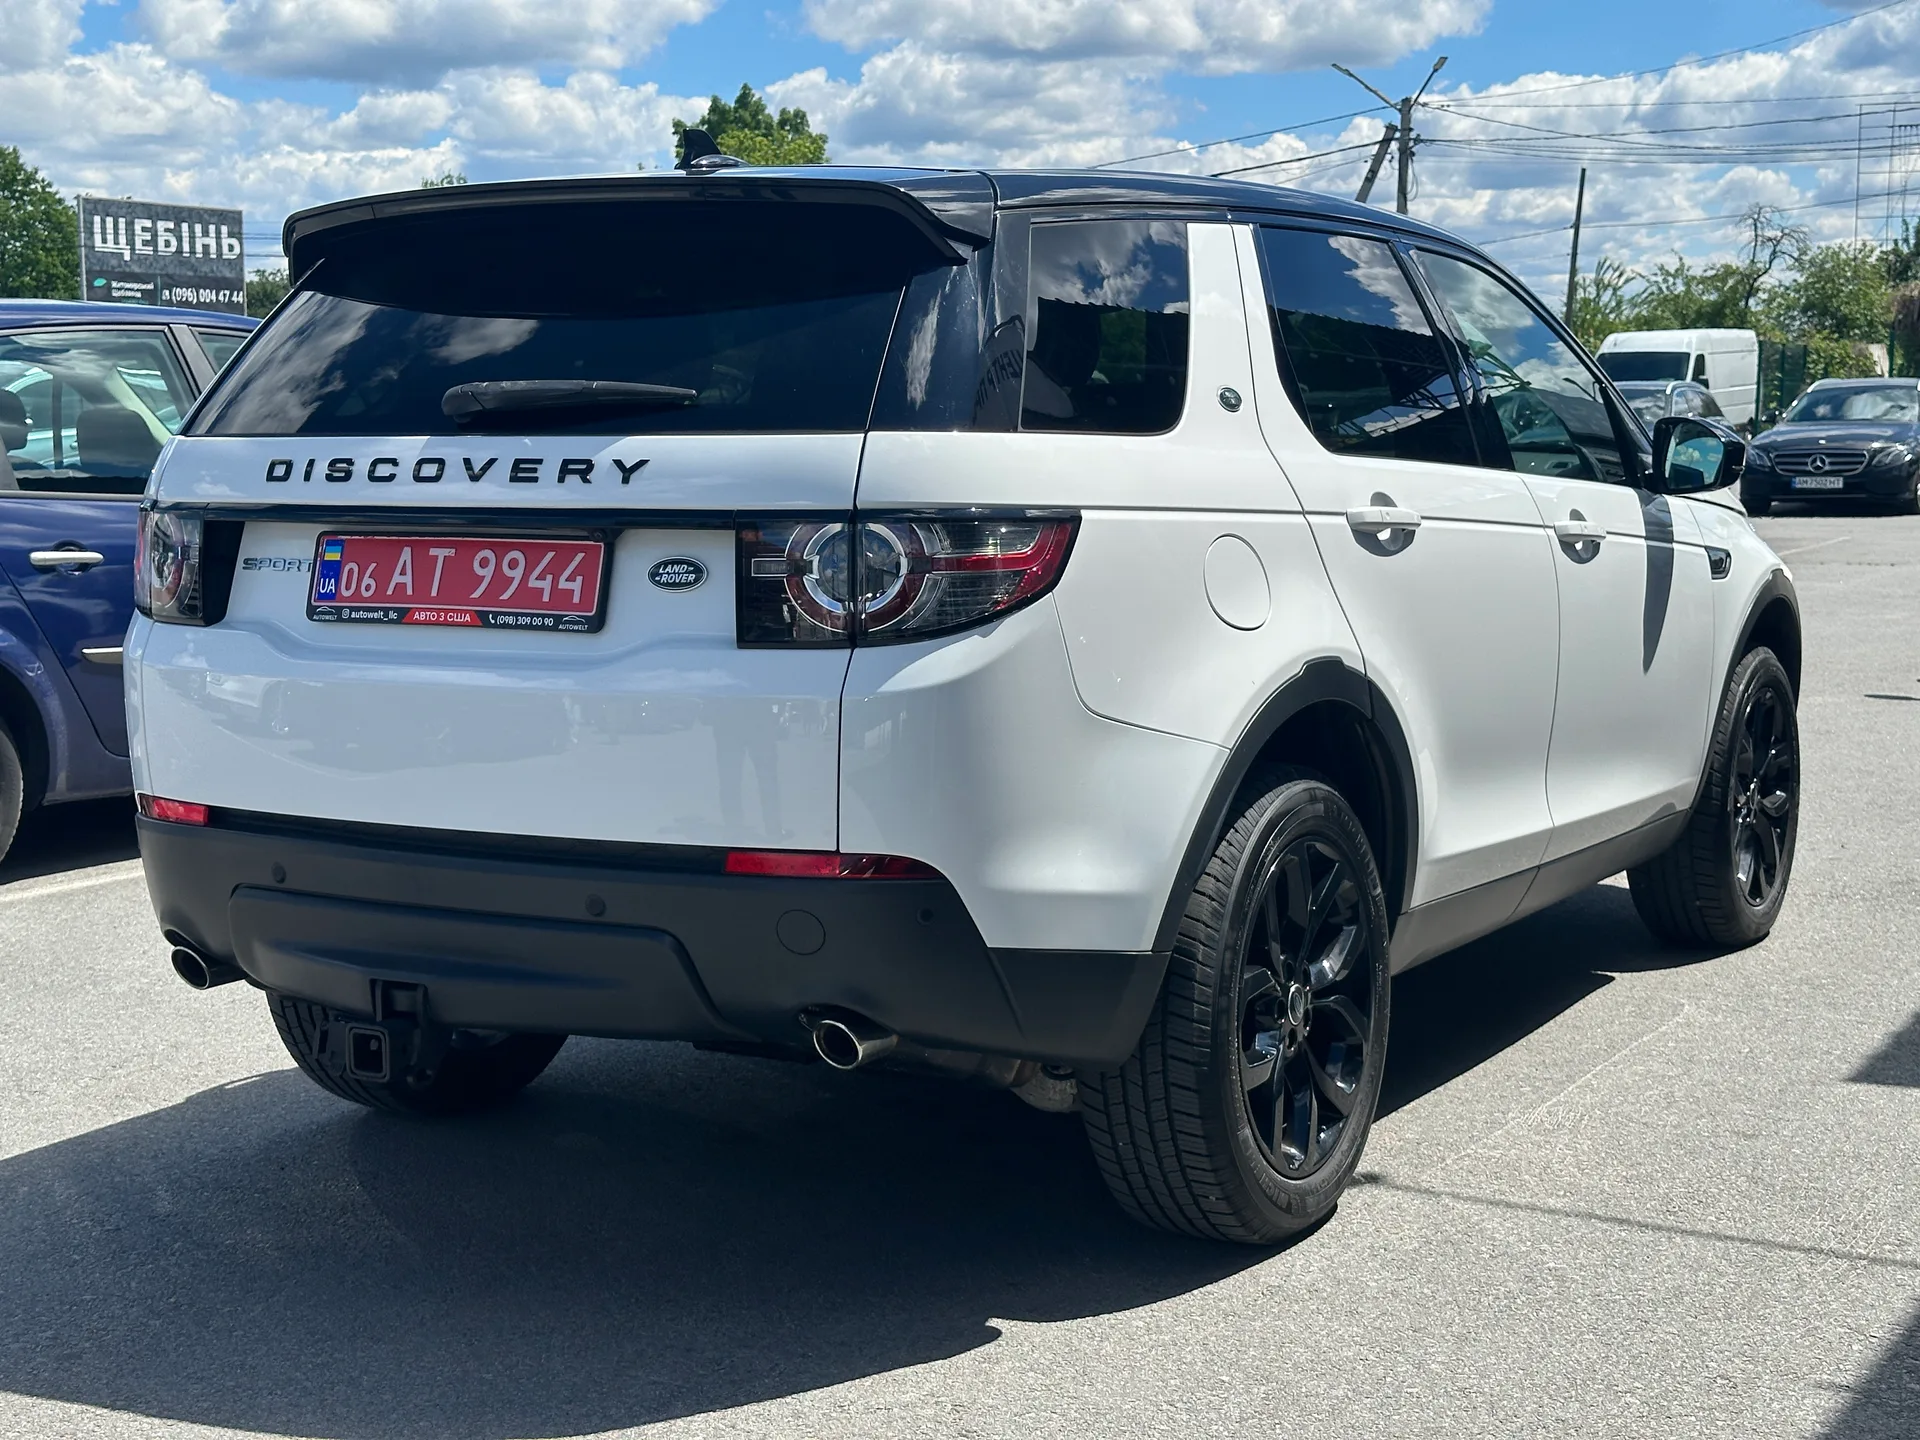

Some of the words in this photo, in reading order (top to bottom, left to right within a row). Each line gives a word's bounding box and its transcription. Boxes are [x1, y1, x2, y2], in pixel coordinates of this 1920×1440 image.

[93, 215, 240, 261] ЩЕБІНЬ
[171, 287, 197, 304] (096)
[199, 288, 216, 303] 004
[218, 289, 230, 303] 47
[231, 290, 243, 304] 44
[266, 457, 650, 484] DISCOVERY
[242, 557, 313, 573] SPORT
[340, 562, 377, 598] 06
[386, 546, 456, 597] AT
[469, 549, 586, 604] 9944
[319, 578, 336, 594] UA
[350, 609, 398, 621] autowelt_llc
[413, 611, 438, 621] АВТО
[447, 613, 471, 623] США
[496, 615, 516, 626] (098)
[516, 616, 531, 625] 309
[532, 617, 543, 626] 00
[543, 618, 554, 626] 90
